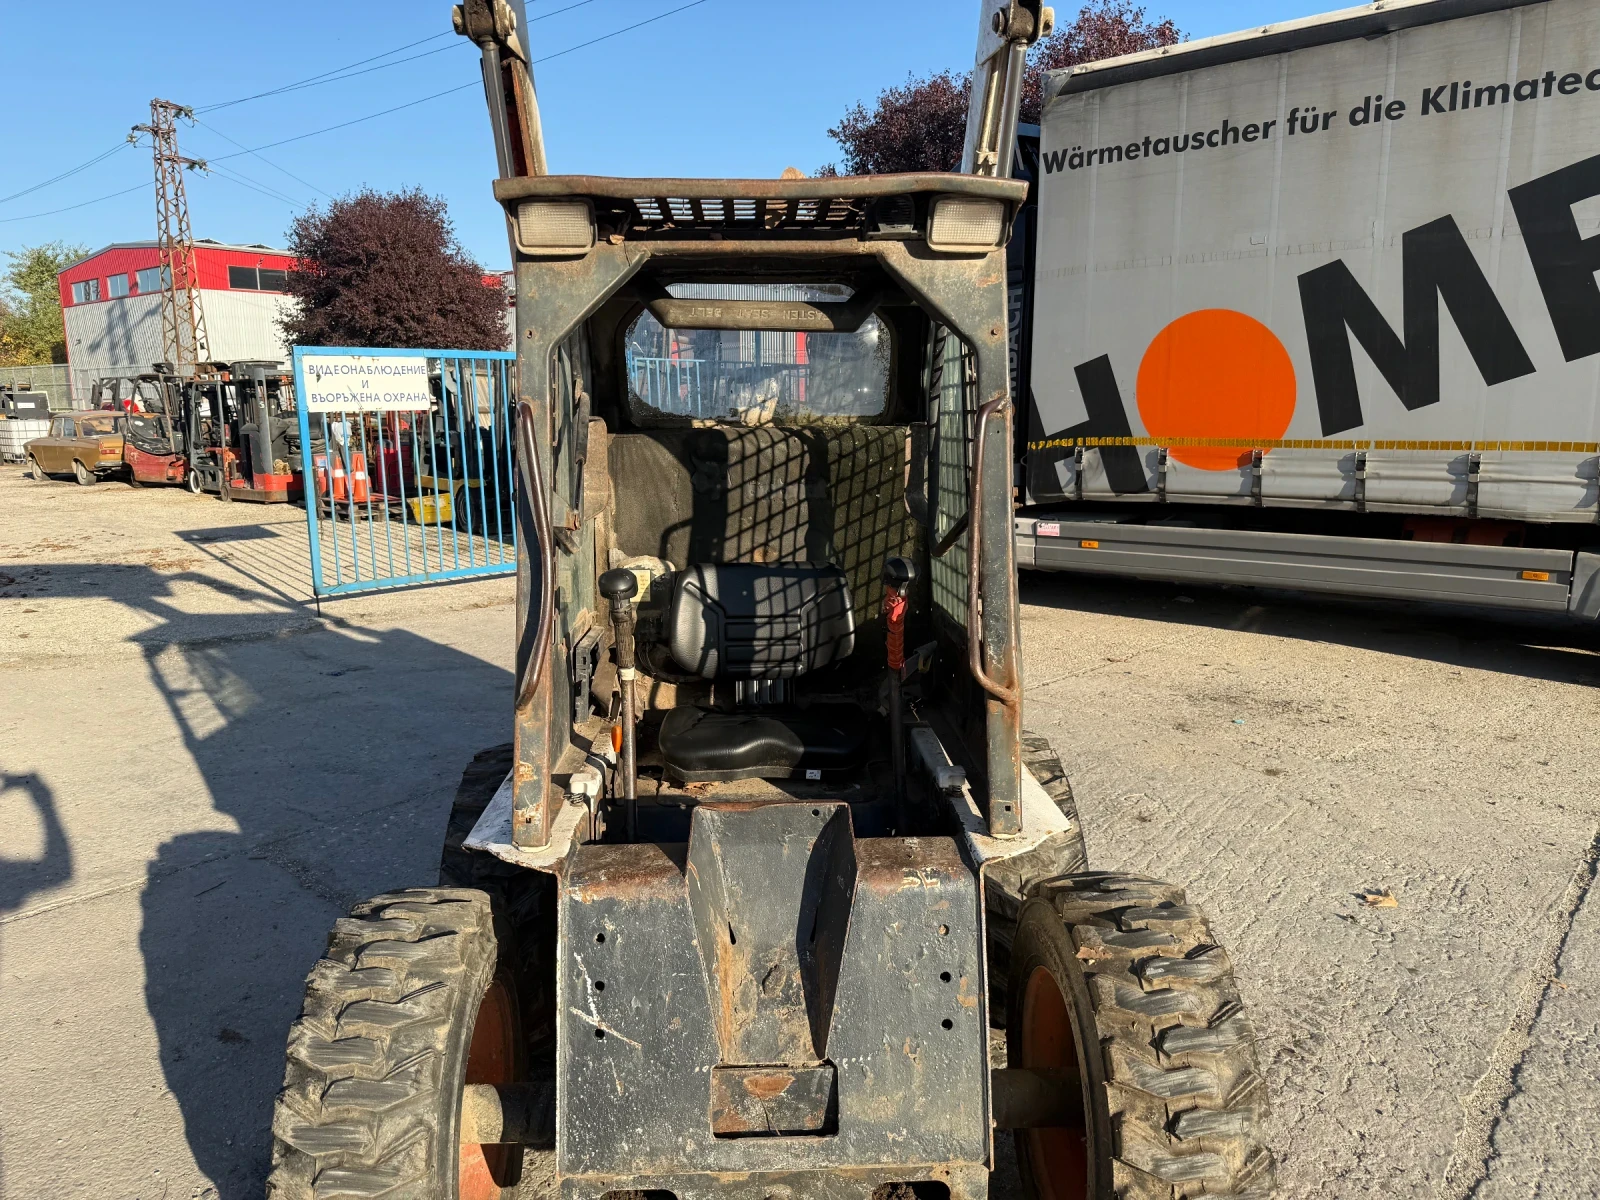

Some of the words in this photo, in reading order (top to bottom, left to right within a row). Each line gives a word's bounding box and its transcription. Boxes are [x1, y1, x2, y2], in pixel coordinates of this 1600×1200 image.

[1042, 118, 1276, 174] Wärmetauscher
[1287, 106, 1338, 136] für
[1349, 94, 1406, 127] die
[689, 307, 723, 318] BELT
[736, 309, 769, 320] SEAT
[308, 364, 427, 377] ВИДЕОНАБЛЮДЕНИЕ
[361, 379, 369, 389] И
[311, 392, 381, 403] ВЪОРЪЖЕНА
[383, 392, 428, 402] ОХРАНА
